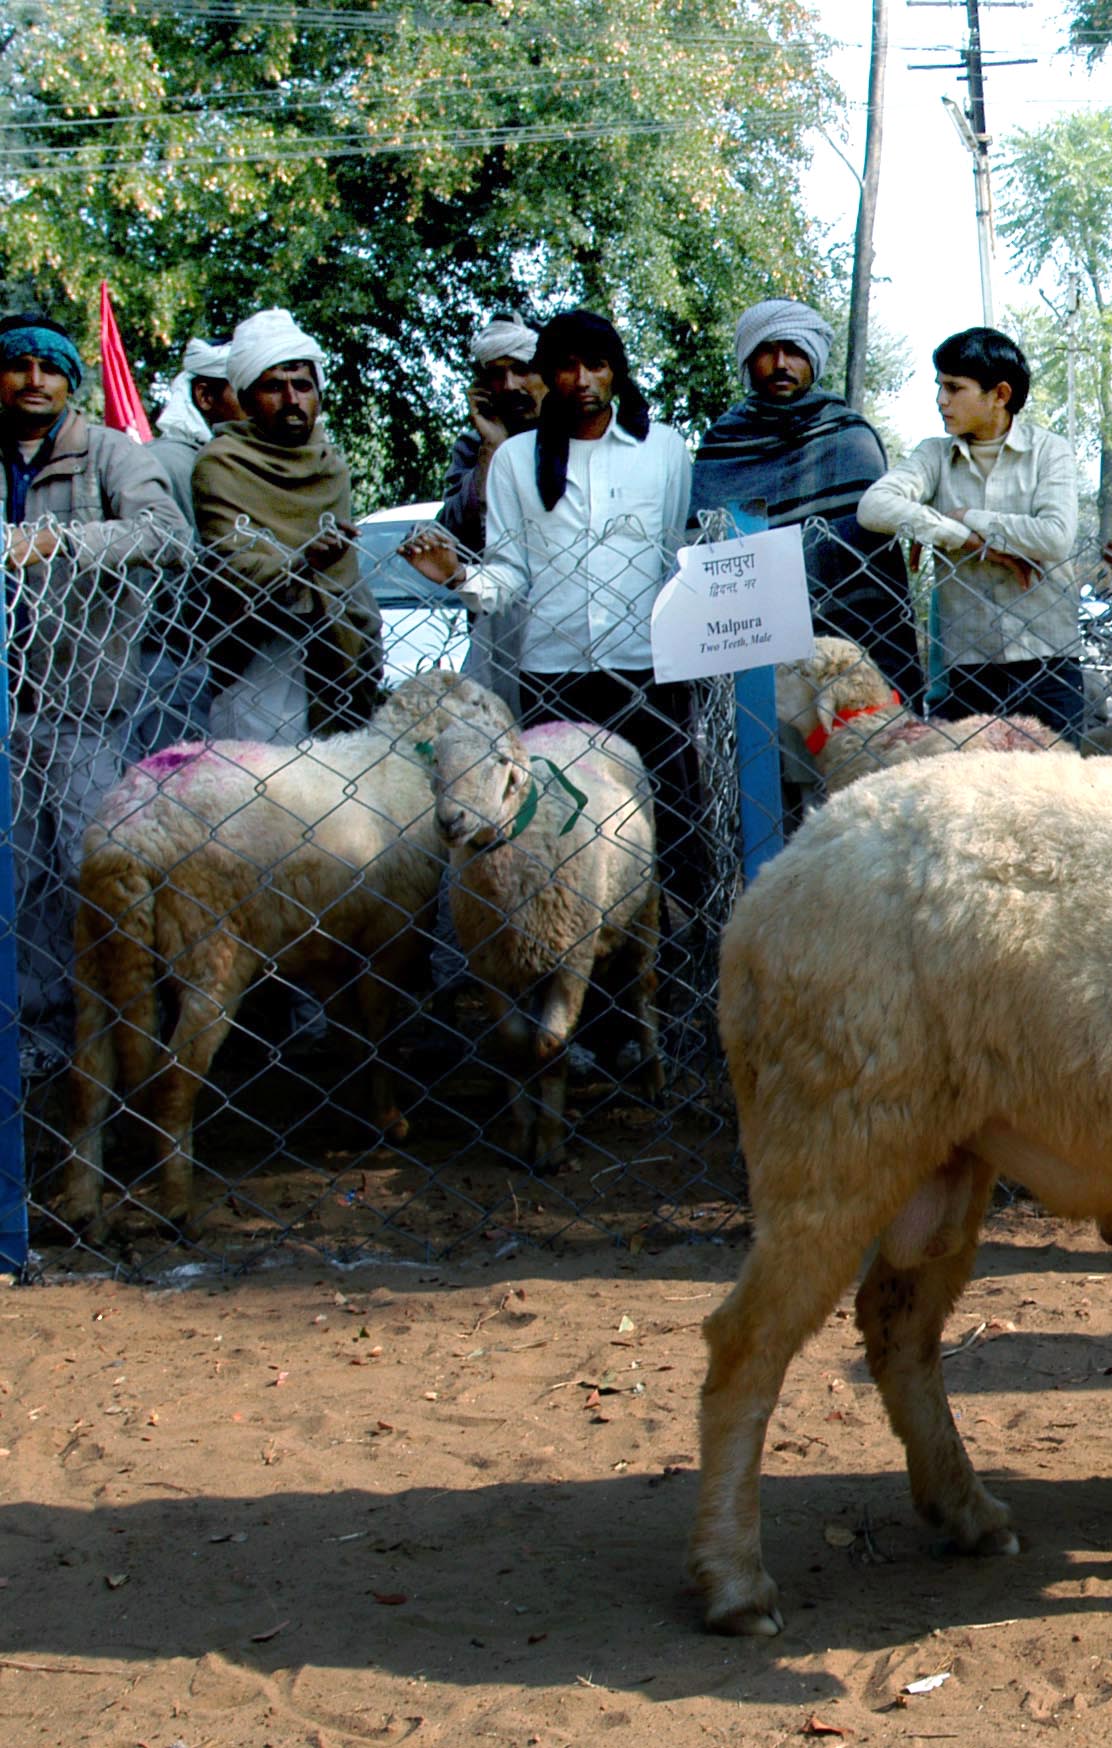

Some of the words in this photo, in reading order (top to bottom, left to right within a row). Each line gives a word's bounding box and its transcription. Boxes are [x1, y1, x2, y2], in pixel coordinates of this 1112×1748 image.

[702, 553, 756, 577] मालपुरा
[744, 579, 757, 589] नर
[707, 616, 763, 637] Malpura
[700, 643, 720, 654] Two
[723, 638, 748, 651] Teeth,
[751, 633, 773, 645] Male
